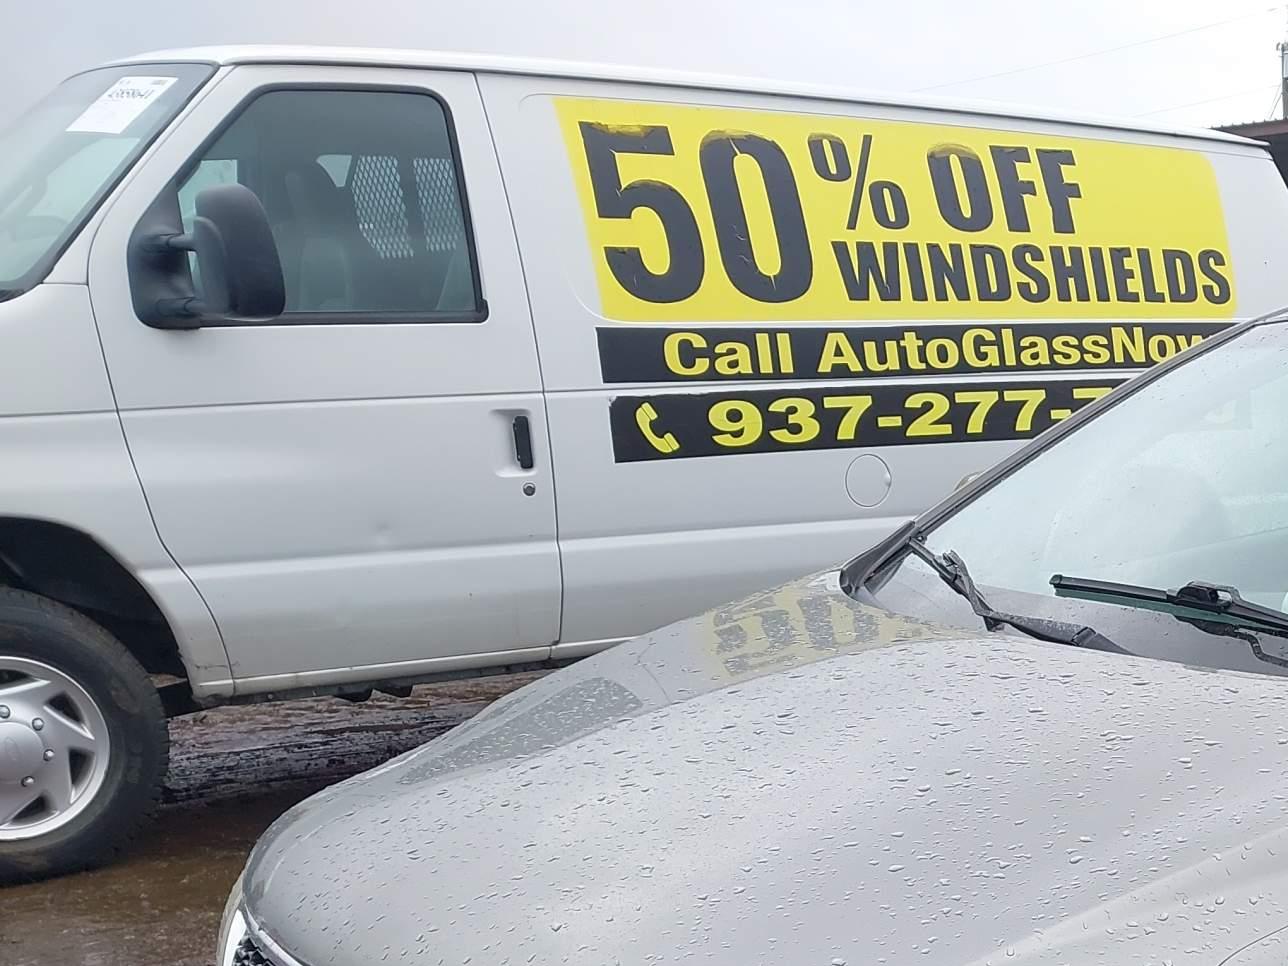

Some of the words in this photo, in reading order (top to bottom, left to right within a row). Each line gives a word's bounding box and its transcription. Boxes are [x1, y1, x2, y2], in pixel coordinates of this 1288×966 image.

[925, 143, 1084, 235] OFF
[830, 240, 1234, 306] WINDSHIELDS
[663, 330, 792, 376] Call
